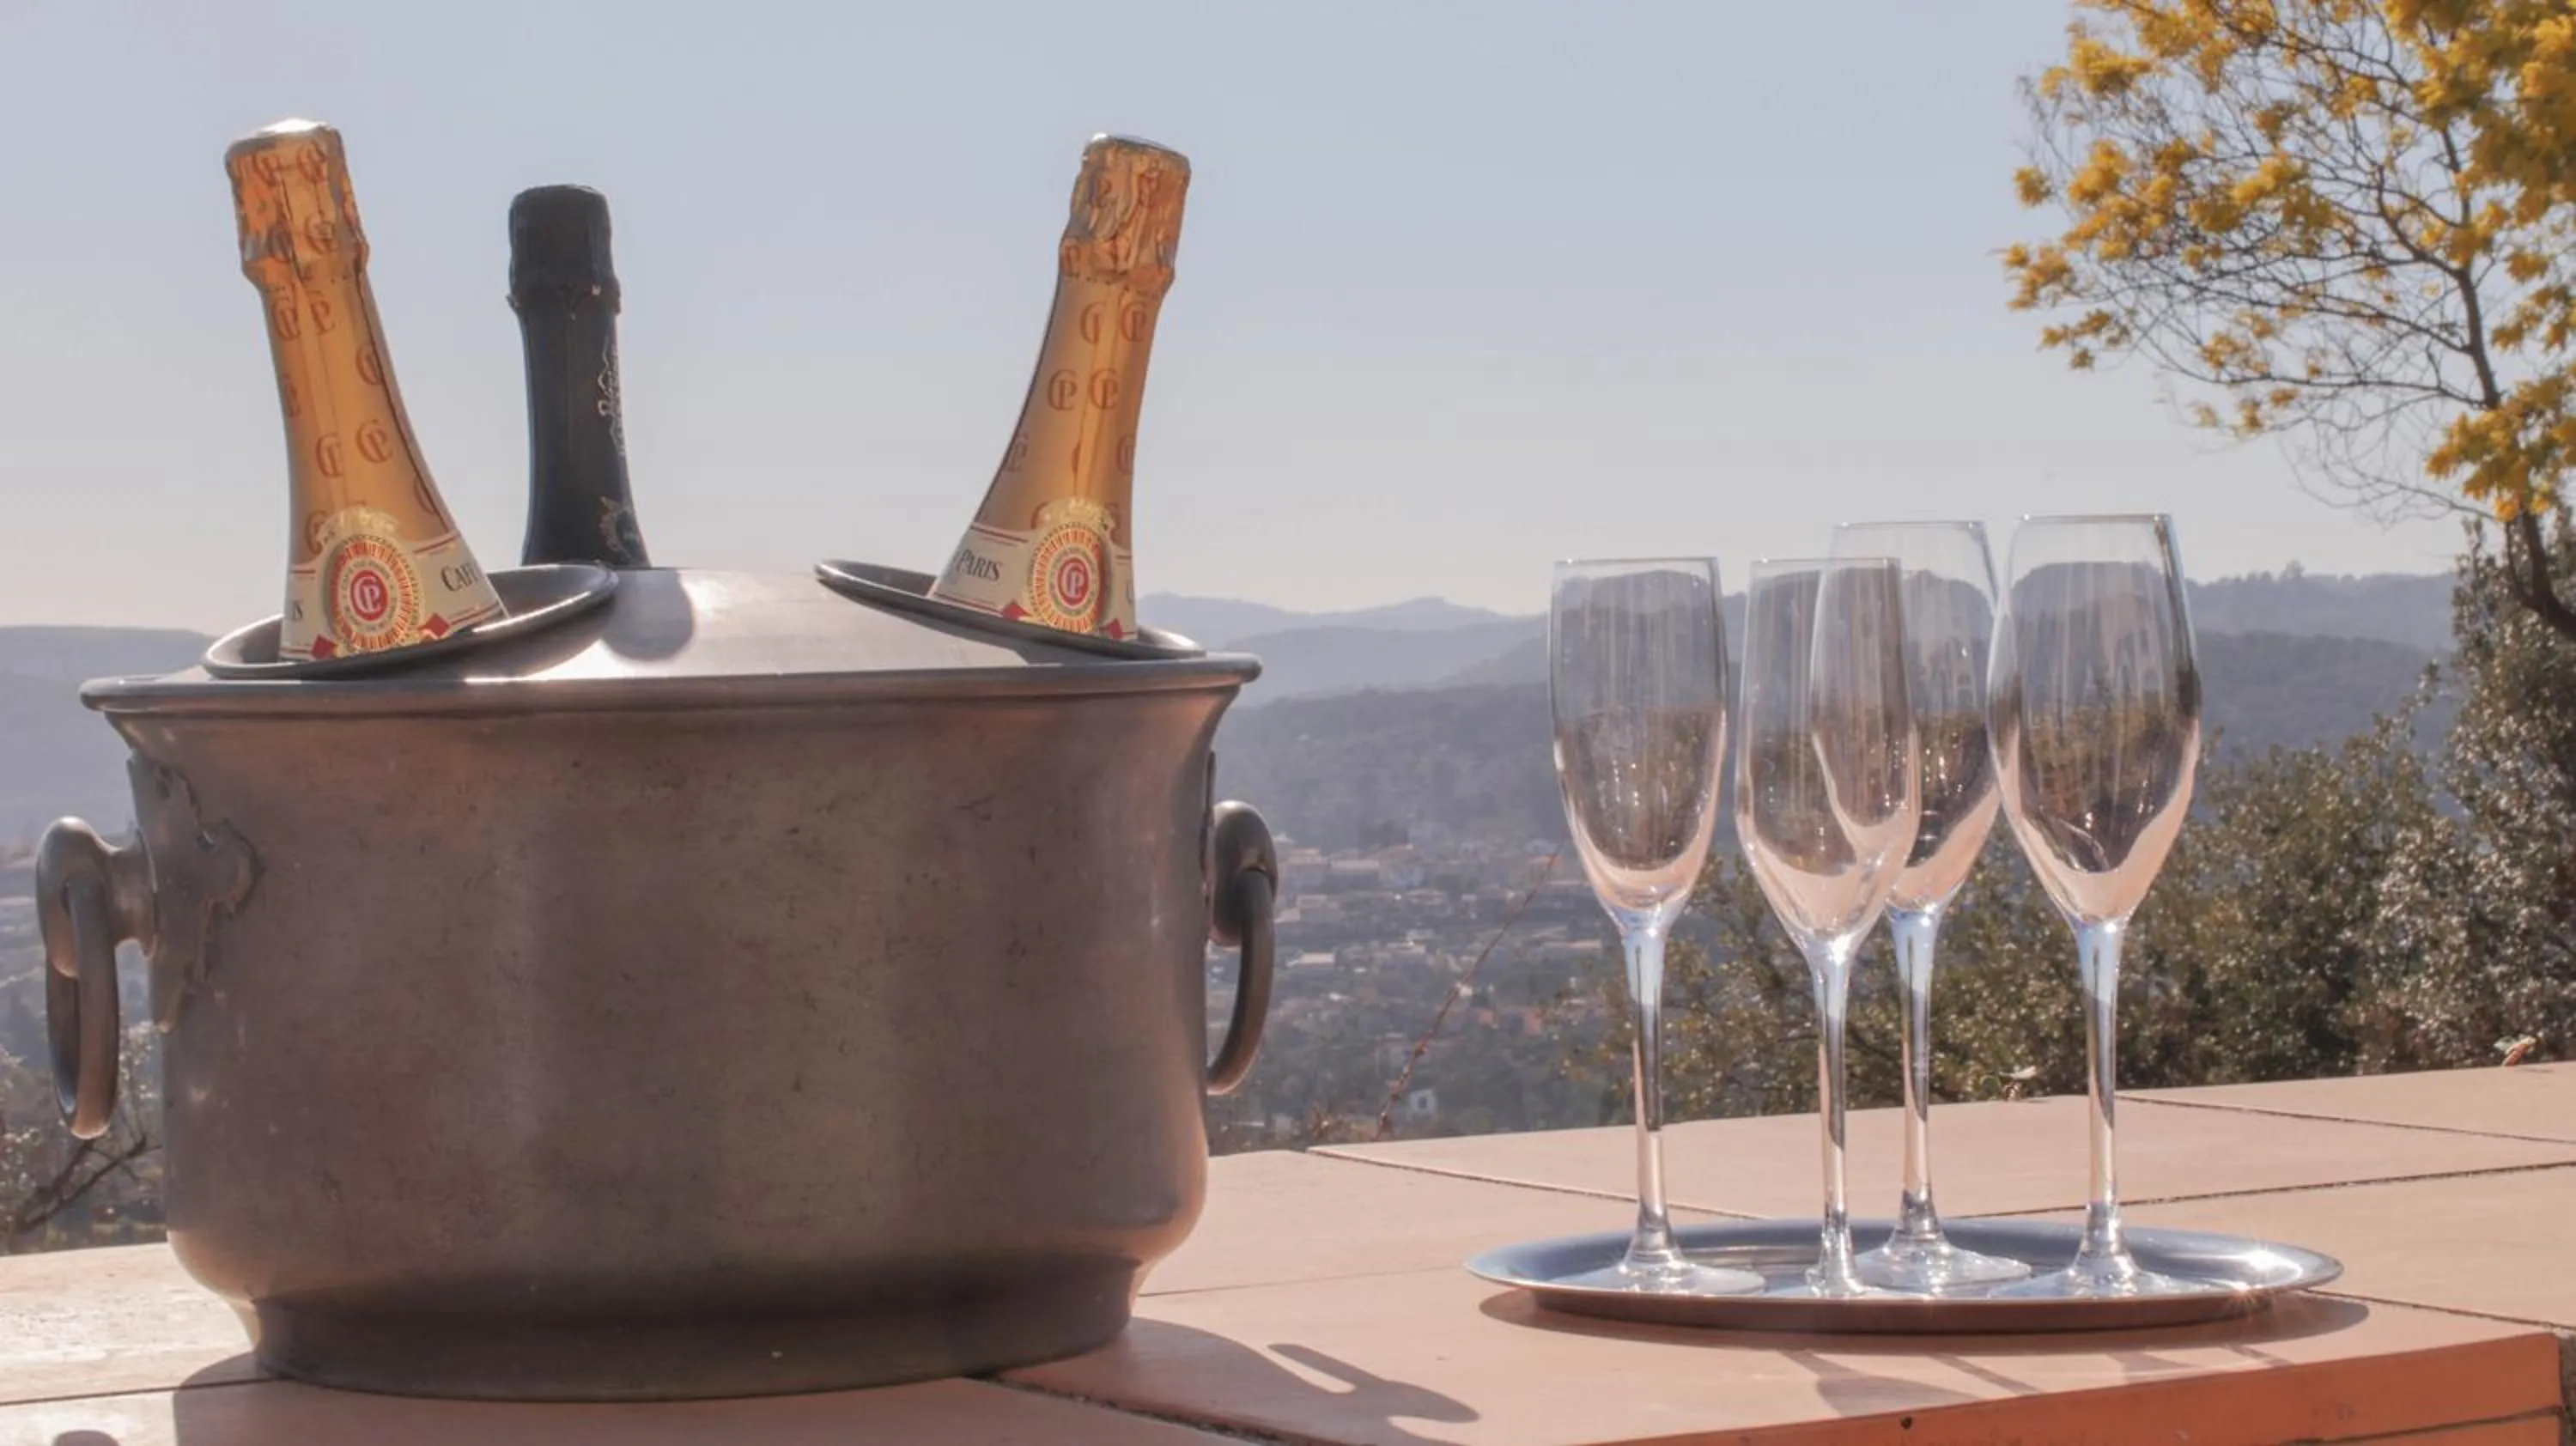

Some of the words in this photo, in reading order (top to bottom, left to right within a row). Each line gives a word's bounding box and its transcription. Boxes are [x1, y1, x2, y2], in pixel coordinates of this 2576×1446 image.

[355, 419, 394, 464] CP
[956, 549, 1003, 582] PARIS
[1060, 562, 1086, 599] CP
[353, 575, 381, 614] CP
